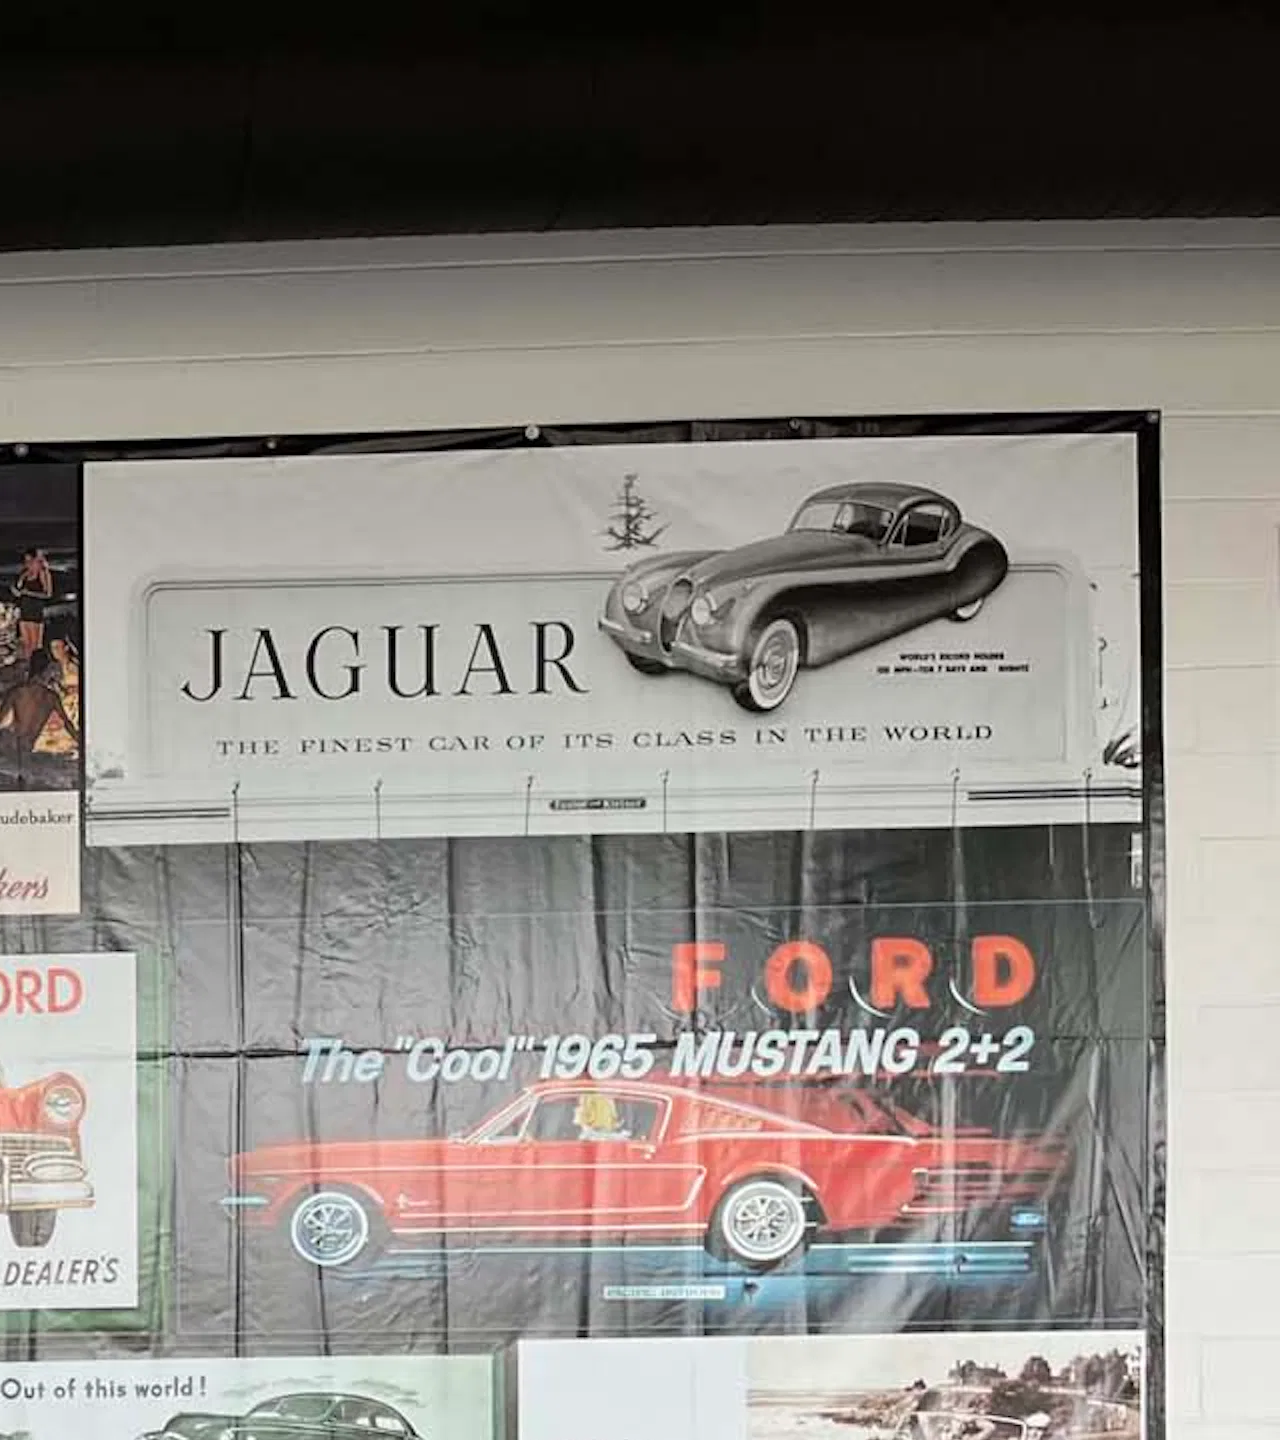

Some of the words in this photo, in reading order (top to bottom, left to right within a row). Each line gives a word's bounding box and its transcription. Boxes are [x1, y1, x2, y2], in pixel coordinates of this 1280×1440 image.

[179, 620, 592, 701] JAGUAR
[216, 739, 280, 756] THE
[300, 736, 414, 754] FINEST
[428, 735, 490, 752] CAR
[505, 734, 545, 751] OF
[563, 732, 615, 750] ITS
[632, 729, 738, 748] CLASS
[755, 728, 787, 745] IN
[804, 725, 868, 743] THE
[882, 724, 993, 742] WORLD
[670, 934, 1036, 1013] FORD
[301, 1035, 386, 1083] The
[393, 1035, 536, 1082] "Cool"
[538, 1032, 658, 1080] 1965
[669, 1027, 920, 1078] MUSTANG
[932, 1025, 1035, 1074] 2+2
[3, 1256, 120, 1287] DEALER'S
[0, 1377, 45, 1400] Out
[53, 1377, 76, 1399] of
[85, 1377, 127, 1399] this
